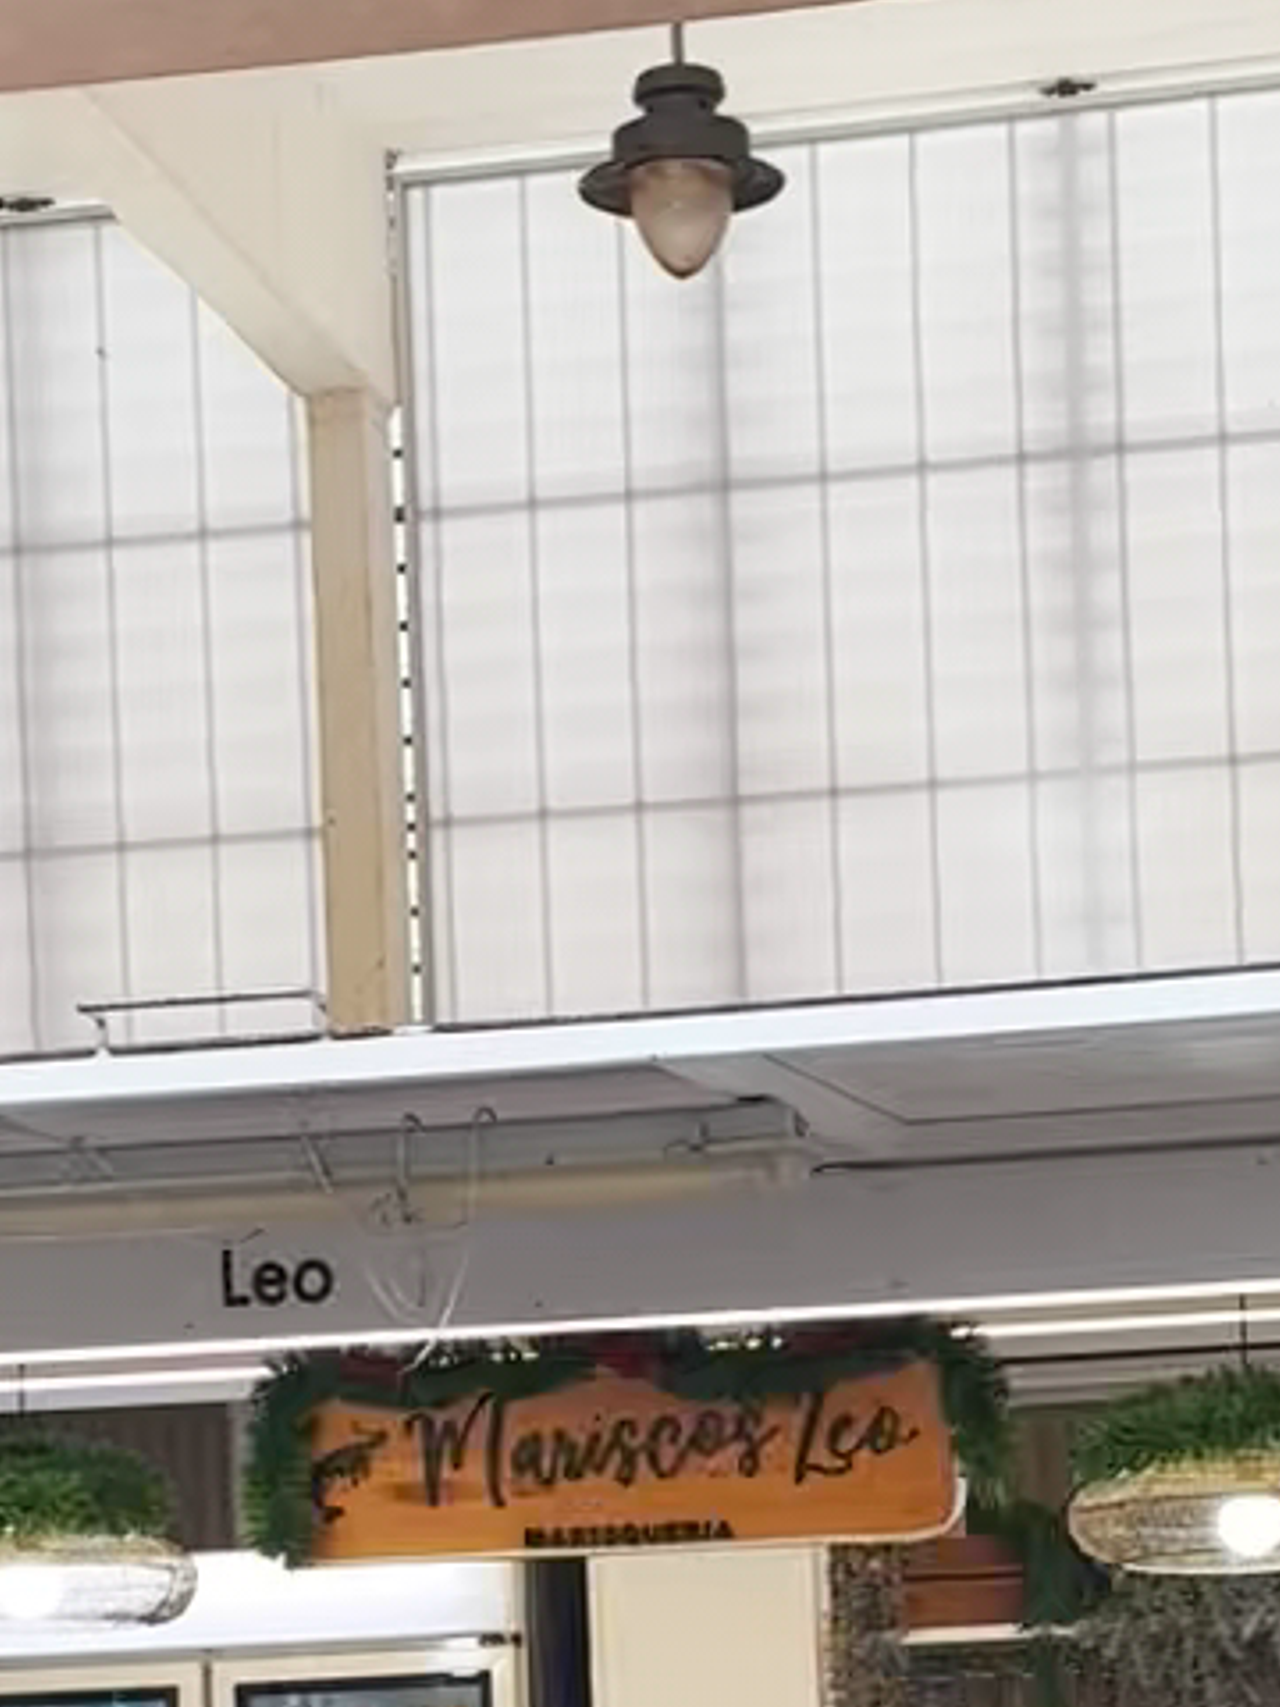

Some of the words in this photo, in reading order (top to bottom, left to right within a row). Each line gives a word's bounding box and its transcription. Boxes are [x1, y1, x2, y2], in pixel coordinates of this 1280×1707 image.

[222, 1249, 333, 1307] Leo
[405, 1391, 780, 1508] Mariscos
[790, 1389, 922, 1486] Leo
